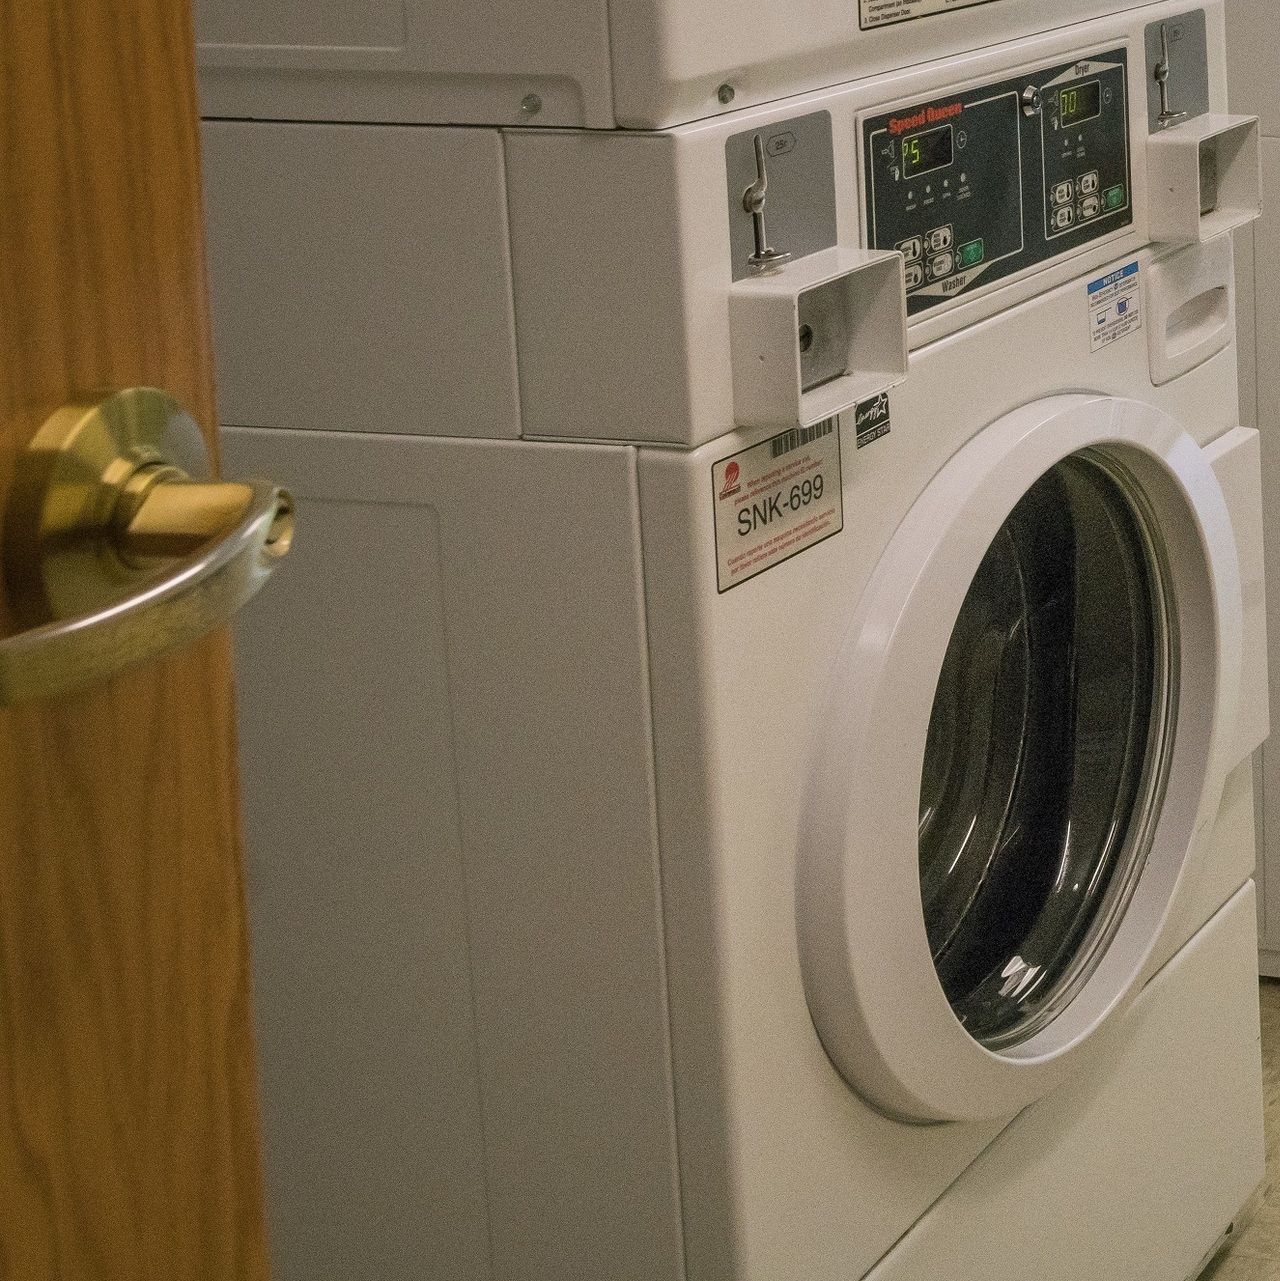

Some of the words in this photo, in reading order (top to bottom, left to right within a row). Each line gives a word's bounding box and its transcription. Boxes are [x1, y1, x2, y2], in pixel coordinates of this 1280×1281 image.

[1074, 64, 1090, 76] Dryer
[889, 110, 925, 136] Speed
[926, 103, 963, 123] Queen
[942, 276, 967, 293] Washer
[1103, 269, 1125, 286] NOTICE
[738, 474, 824, 536] SNK-699
